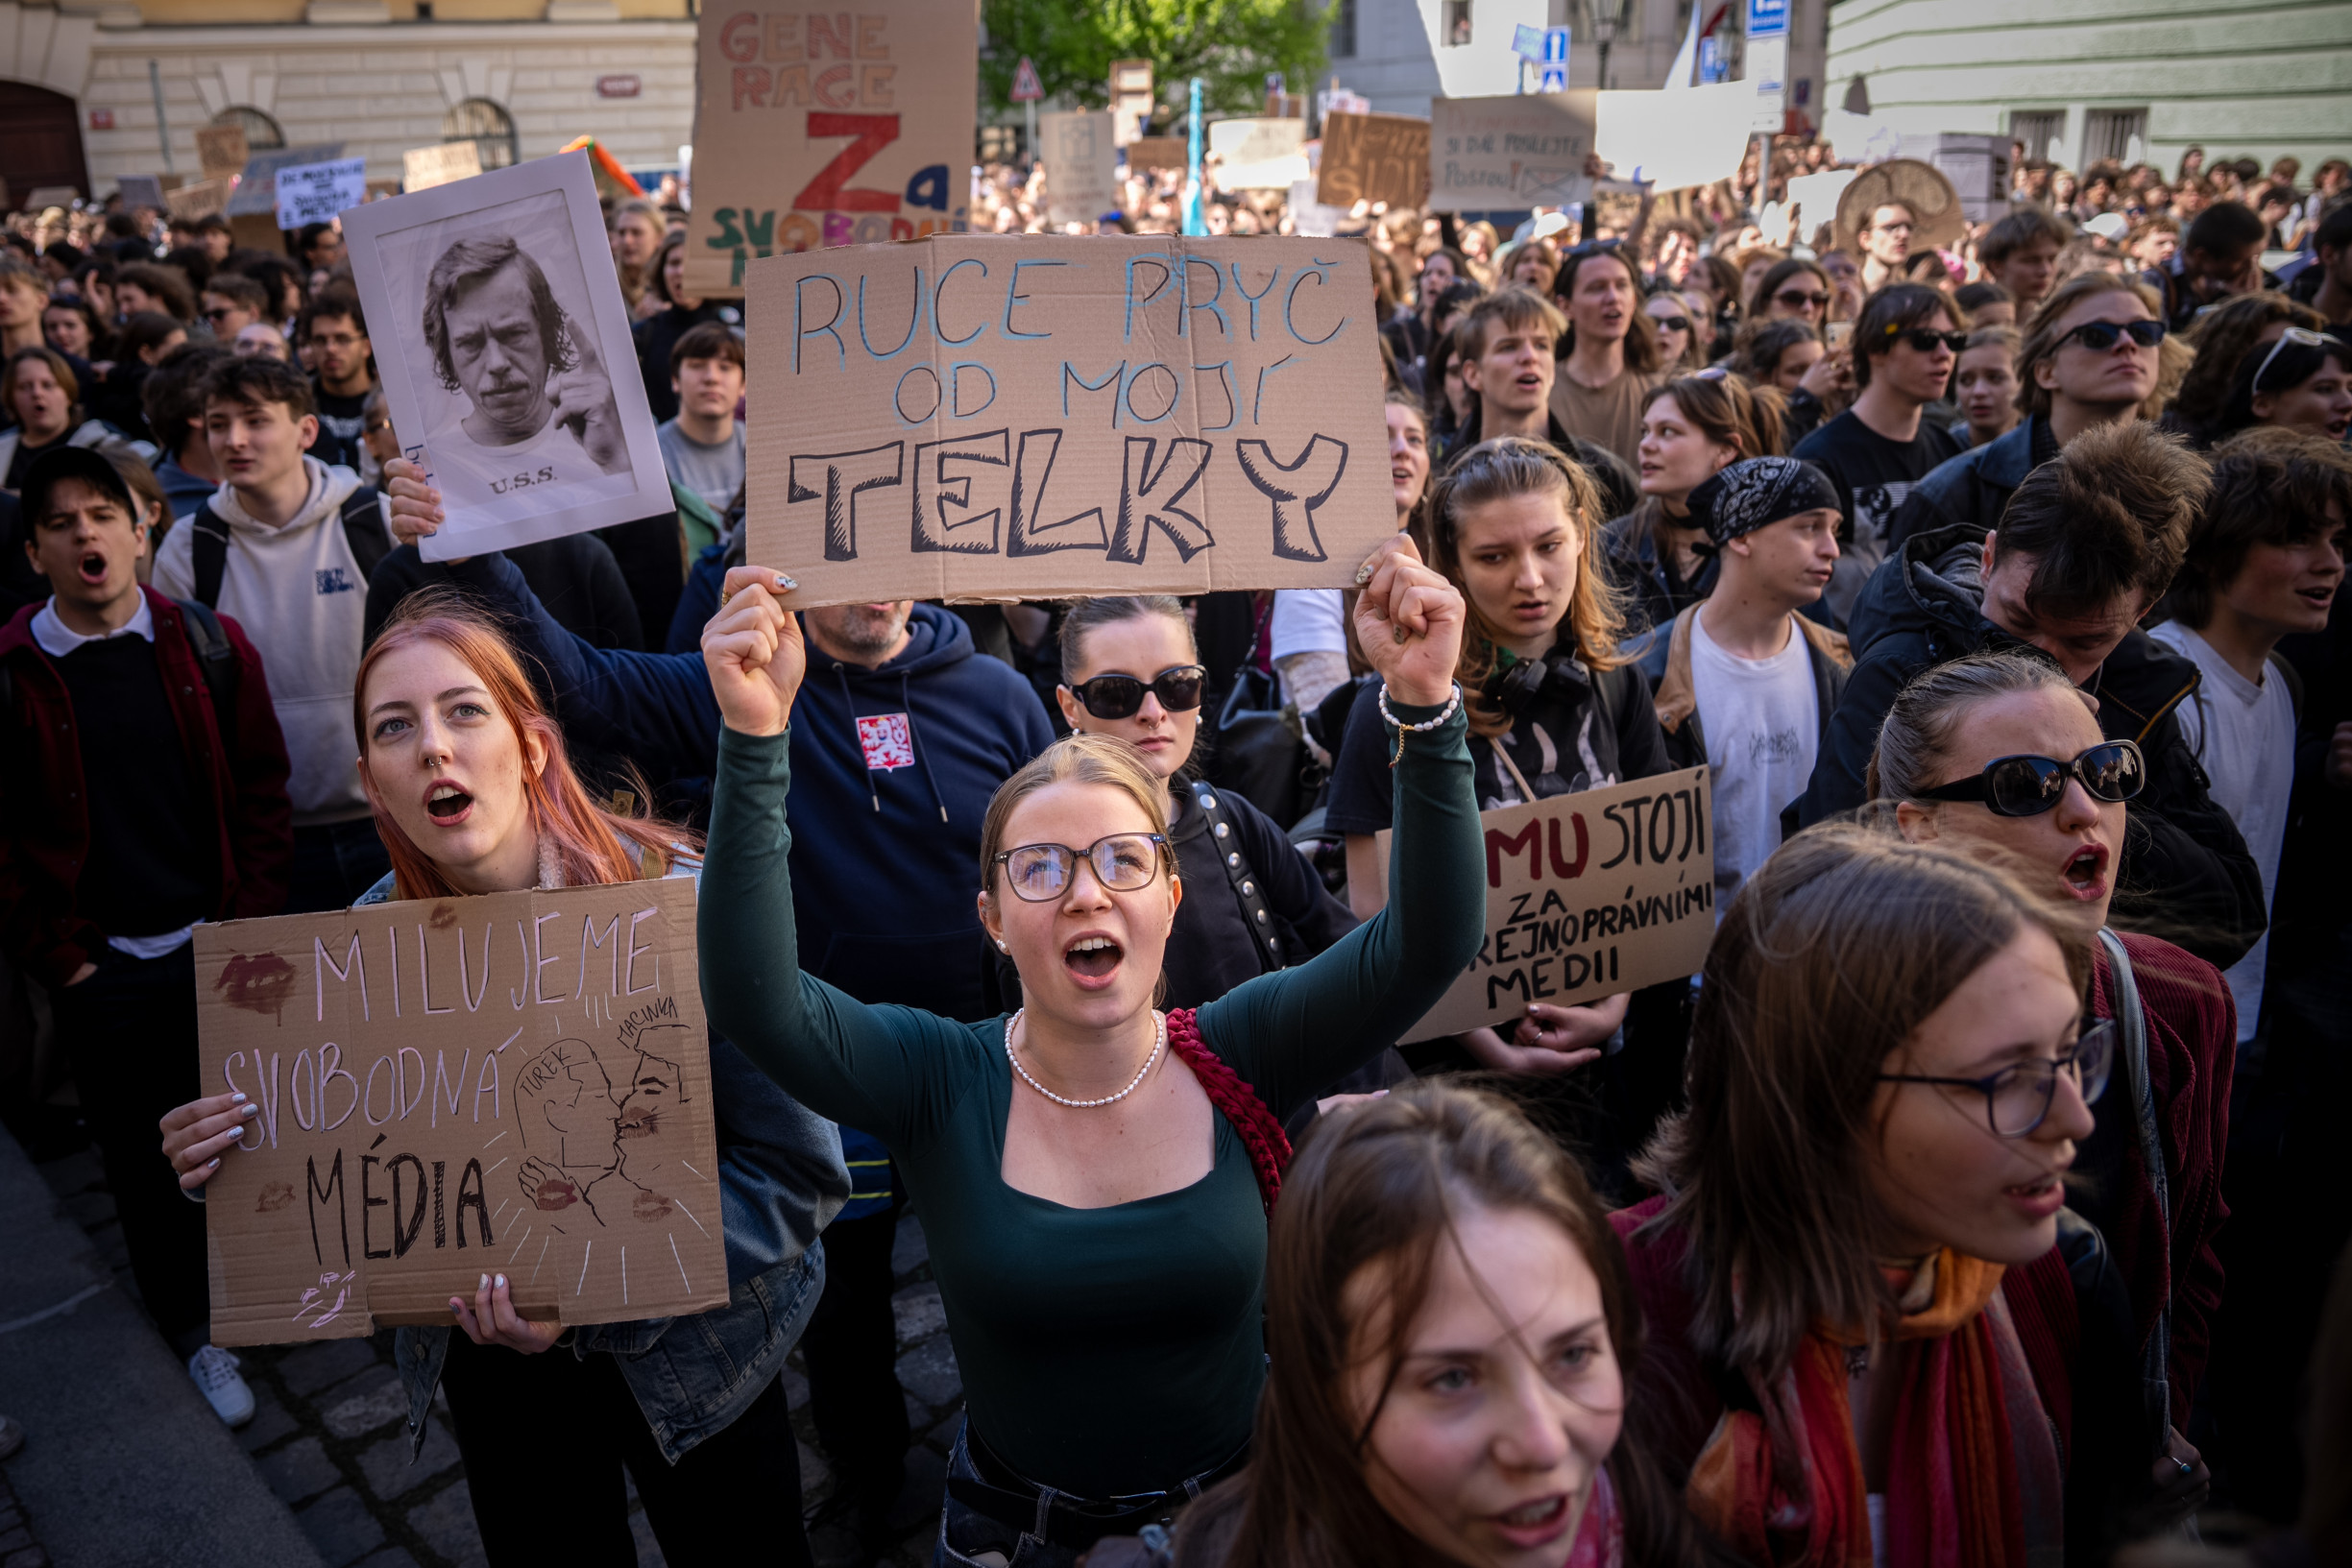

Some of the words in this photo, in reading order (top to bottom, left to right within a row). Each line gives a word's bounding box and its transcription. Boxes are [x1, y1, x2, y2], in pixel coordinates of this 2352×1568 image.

[720, 12, 891, 62] GENE
[732, 63, 899, 111] RACE
[790, 258, 1085, 375] RUCE
[1124, 253, 1353, 346] PRYČ
[892, 361, 997, 430] OD
[1059, 352, 1308, 432] MOJÍ
[488, 466, 558, 495] U.S.S.
[788, 427, 1348, 565] TELKY
[1599, 769, 1705, 869] STOJÍ
[1506, 889, 1567, 925] ZA
[314, 906, 658, 1023] MILUJEME
[1487, 947, 1619, 1010] MÉDII
[617, 995, 678, 1049] MACINKA
[223, 1026, 522, 1151] SVOBODNÁ
[520, 1046, 572, 1098] TUREK
[306, 1132, 496, 1269] MÉDIA
